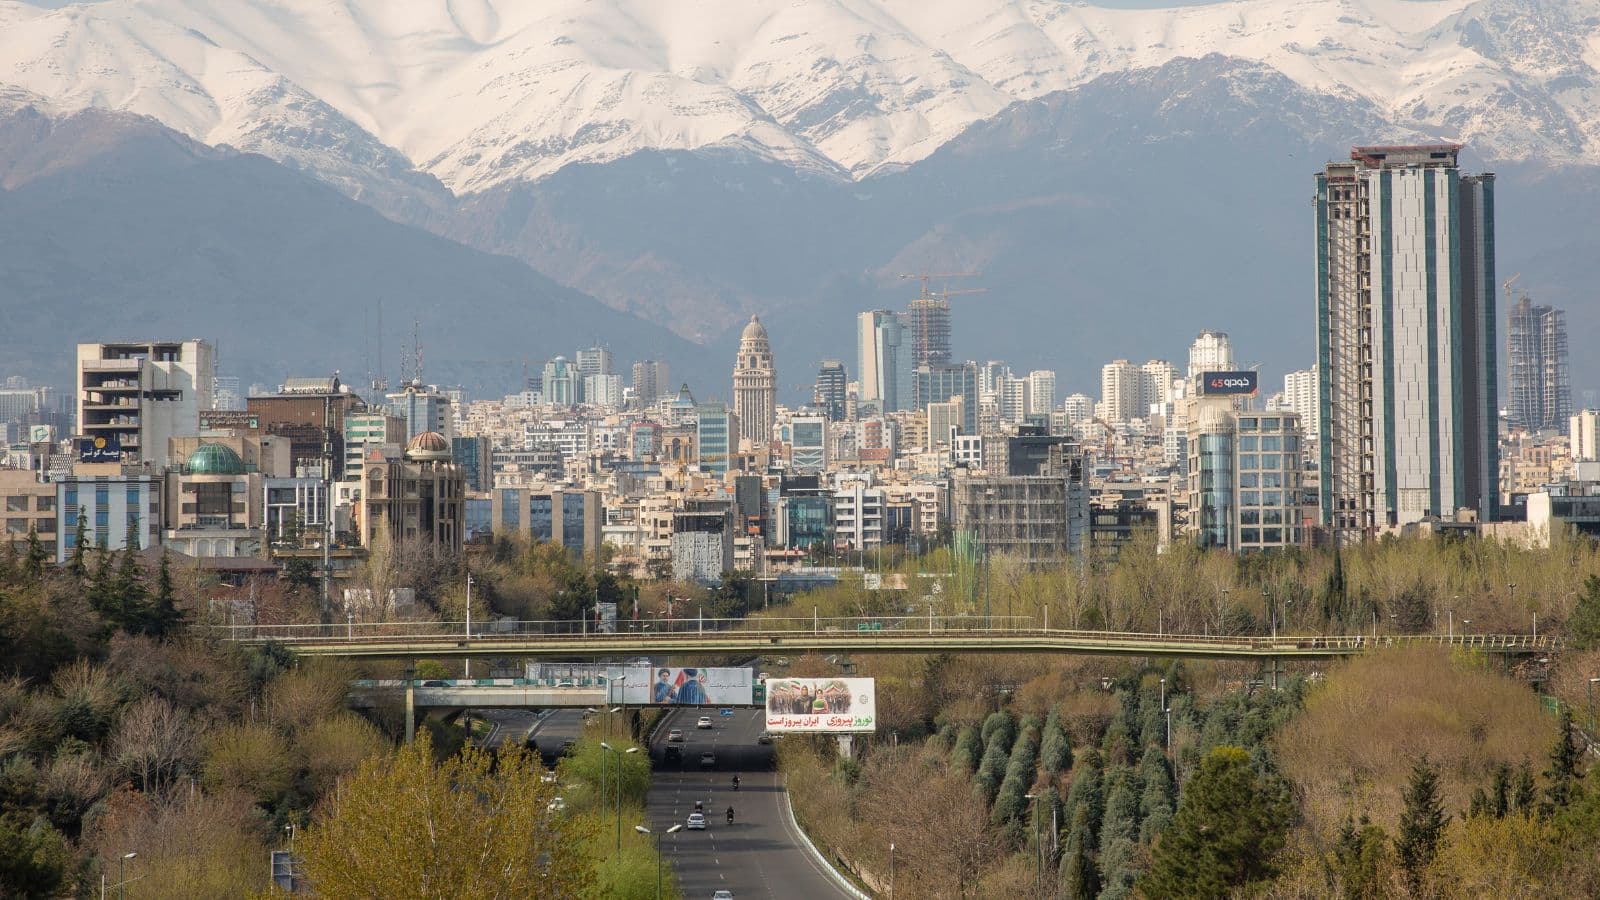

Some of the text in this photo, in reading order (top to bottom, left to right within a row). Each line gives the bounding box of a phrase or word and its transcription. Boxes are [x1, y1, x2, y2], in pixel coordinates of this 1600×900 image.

[82, 446, 119, 458] بیمه کوثر
[803, 716, 819, 727] ایران
[827, 716, 853, 728] پیروزی
[854, 715, 872, 727] نوروز
